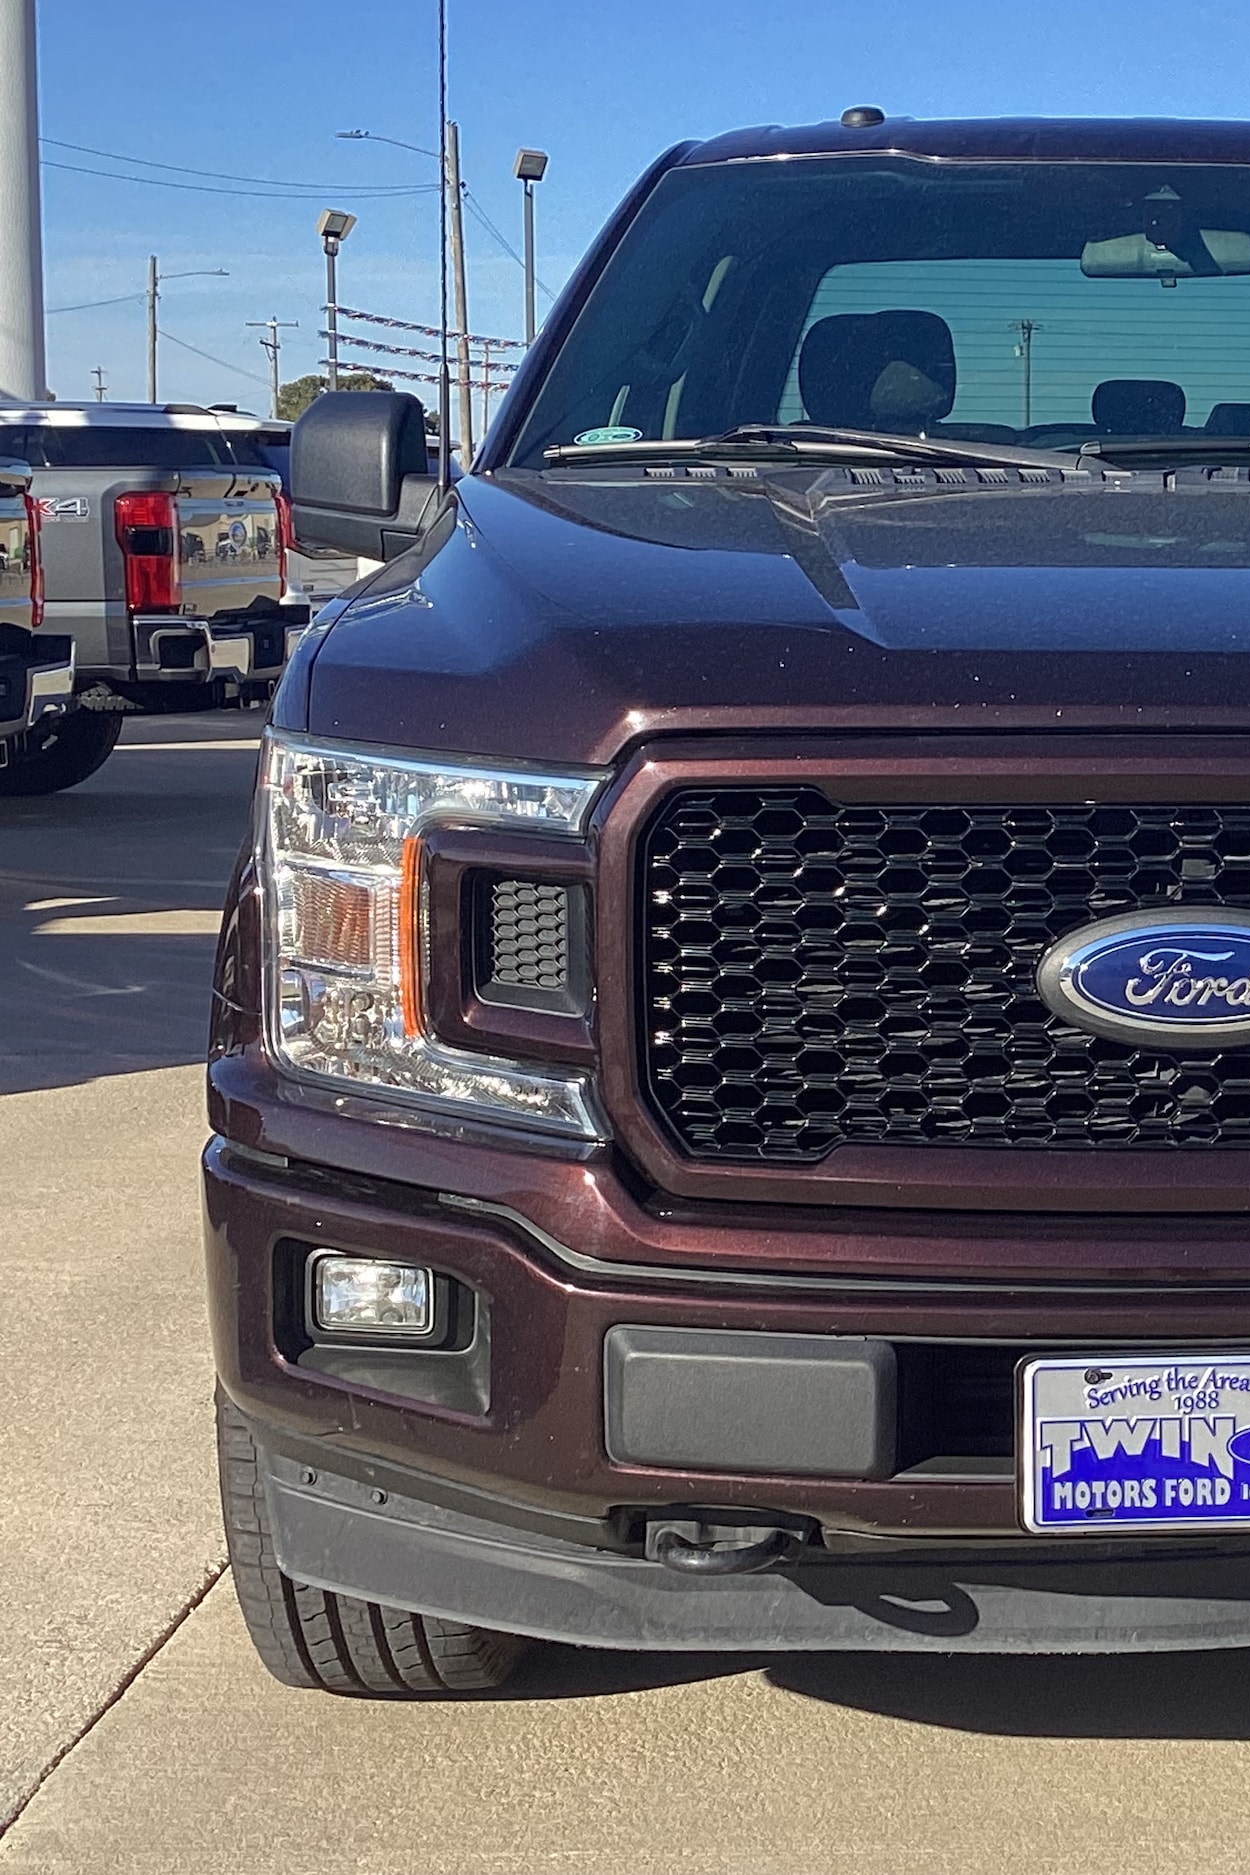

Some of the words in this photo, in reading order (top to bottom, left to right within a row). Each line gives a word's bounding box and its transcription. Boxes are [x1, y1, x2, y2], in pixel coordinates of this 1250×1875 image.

[1086, 1377, 1162, 1409] Serving
[1166, 1367, 1198, 1391] the
[1174, 1390, 1220, 1415] 1988
[1040, 1417, 1235, 1480] TWIN
[1053, 1478, 1156, 1511] MOTORS
[1164, 1476, 1231, 1507] FORD
